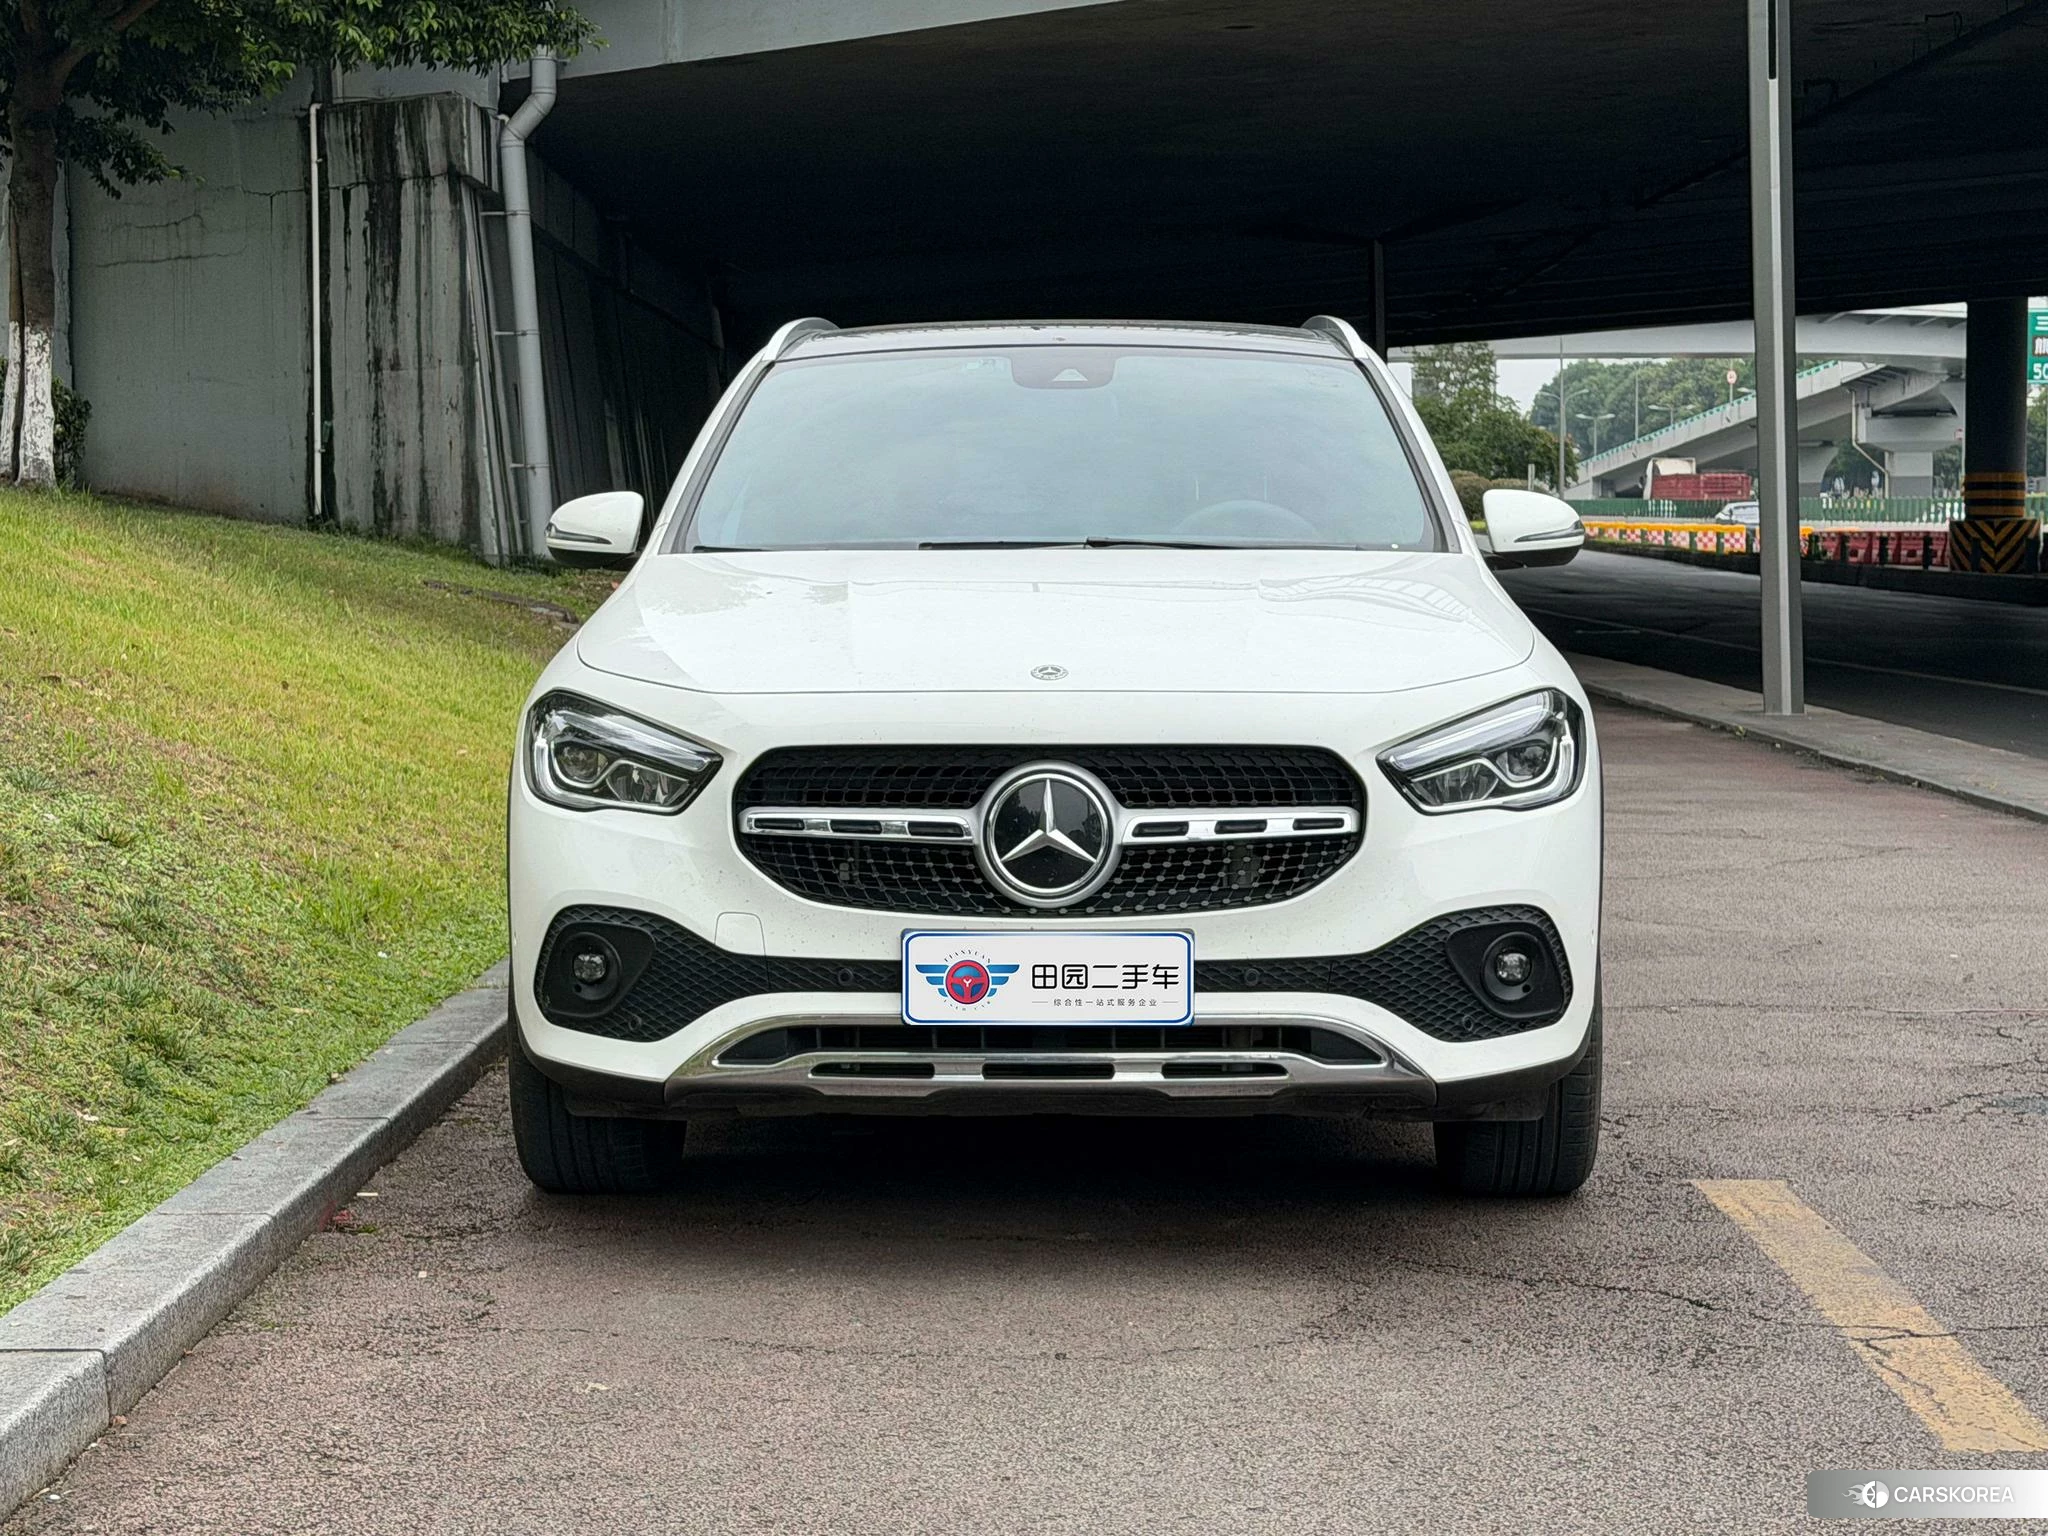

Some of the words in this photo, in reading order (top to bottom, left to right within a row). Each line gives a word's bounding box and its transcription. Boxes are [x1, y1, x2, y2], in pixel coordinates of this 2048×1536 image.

[1032, 964, 1179, 989] 田园二手车
[1053, 998, 1157, 1007] 综合性一站式服务企业
